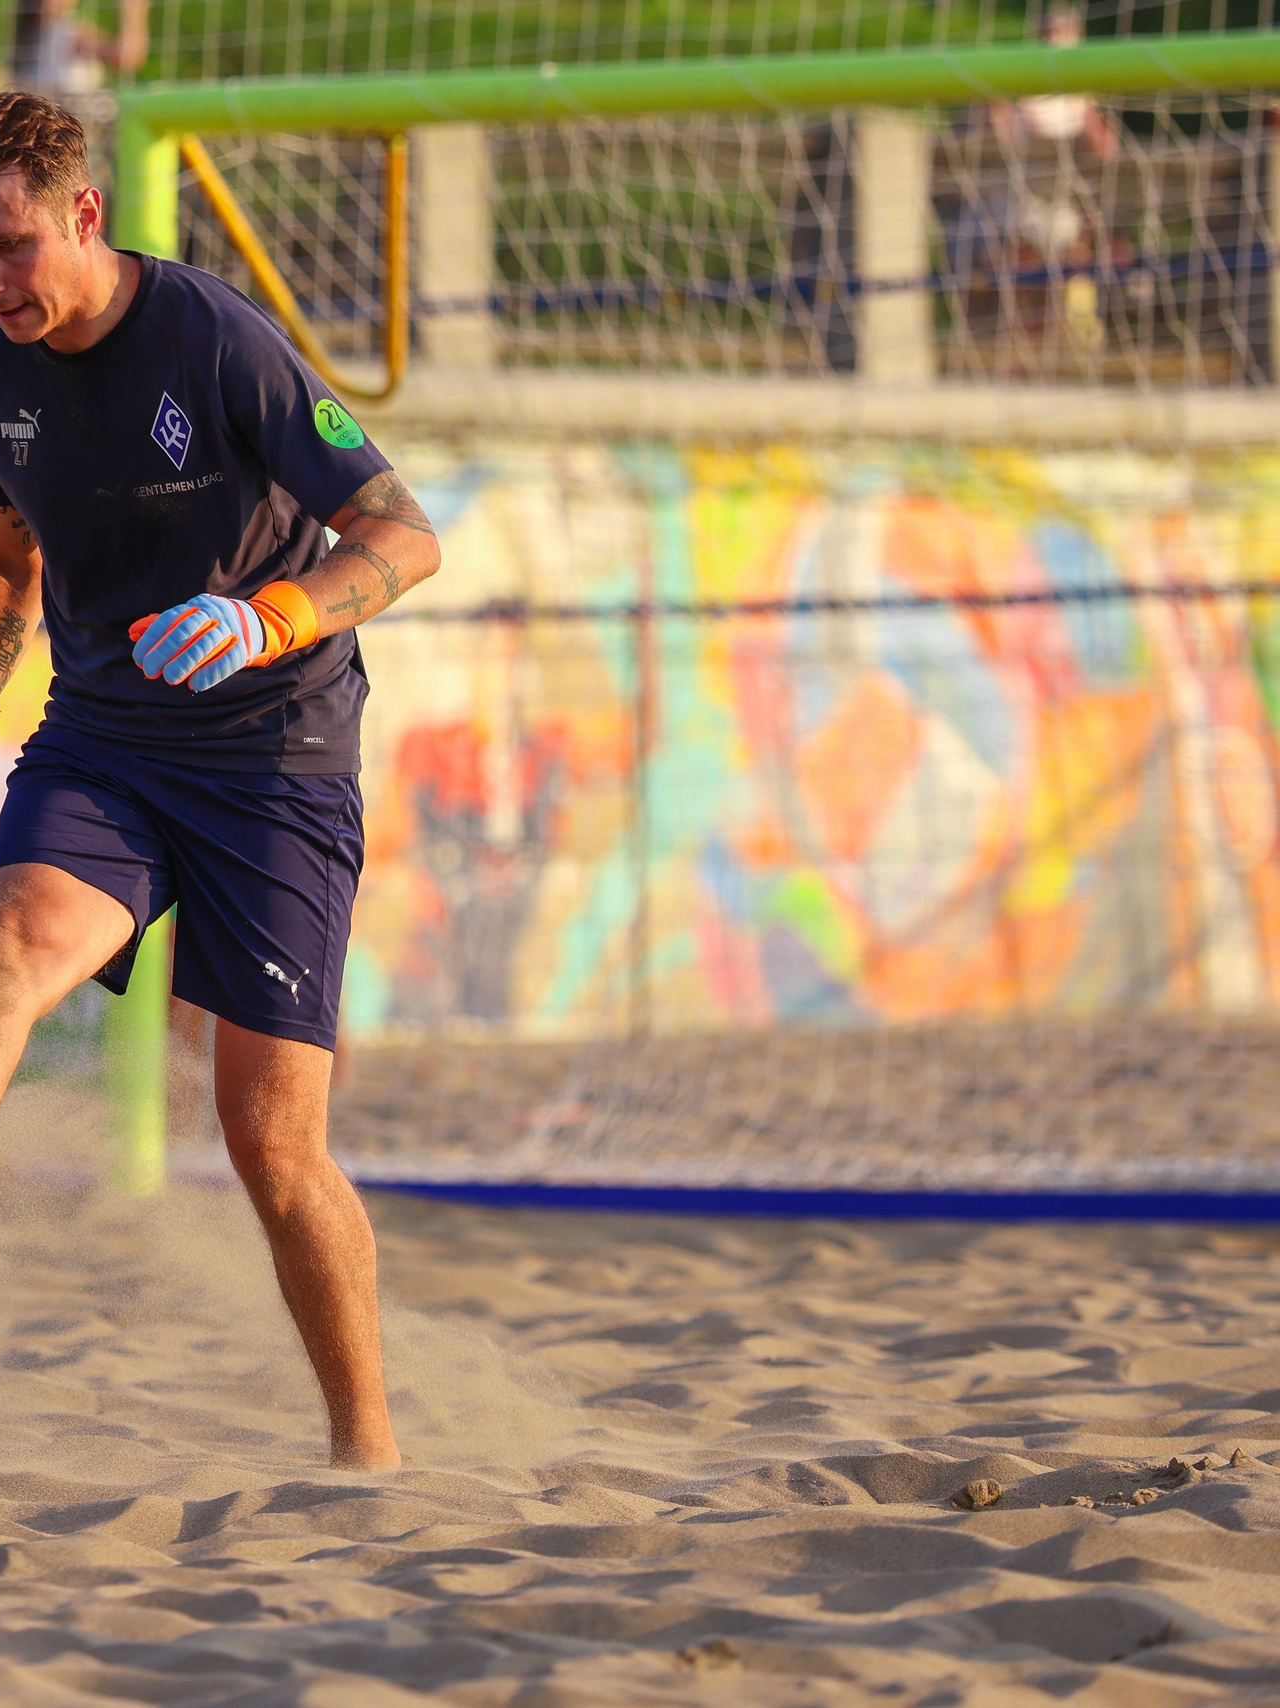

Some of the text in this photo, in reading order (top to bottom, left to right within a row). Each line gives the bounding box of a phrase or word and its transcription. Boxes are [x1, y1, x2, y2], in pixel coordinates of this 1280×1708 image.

[0, 422, 35, 439] PUMA
[318, 403, 346, 432] 27
[11, 440, 28, 466] 27
[133, 480, 195, 498] GENTLEMEN
[197, 471, 224, 488] LEAG
